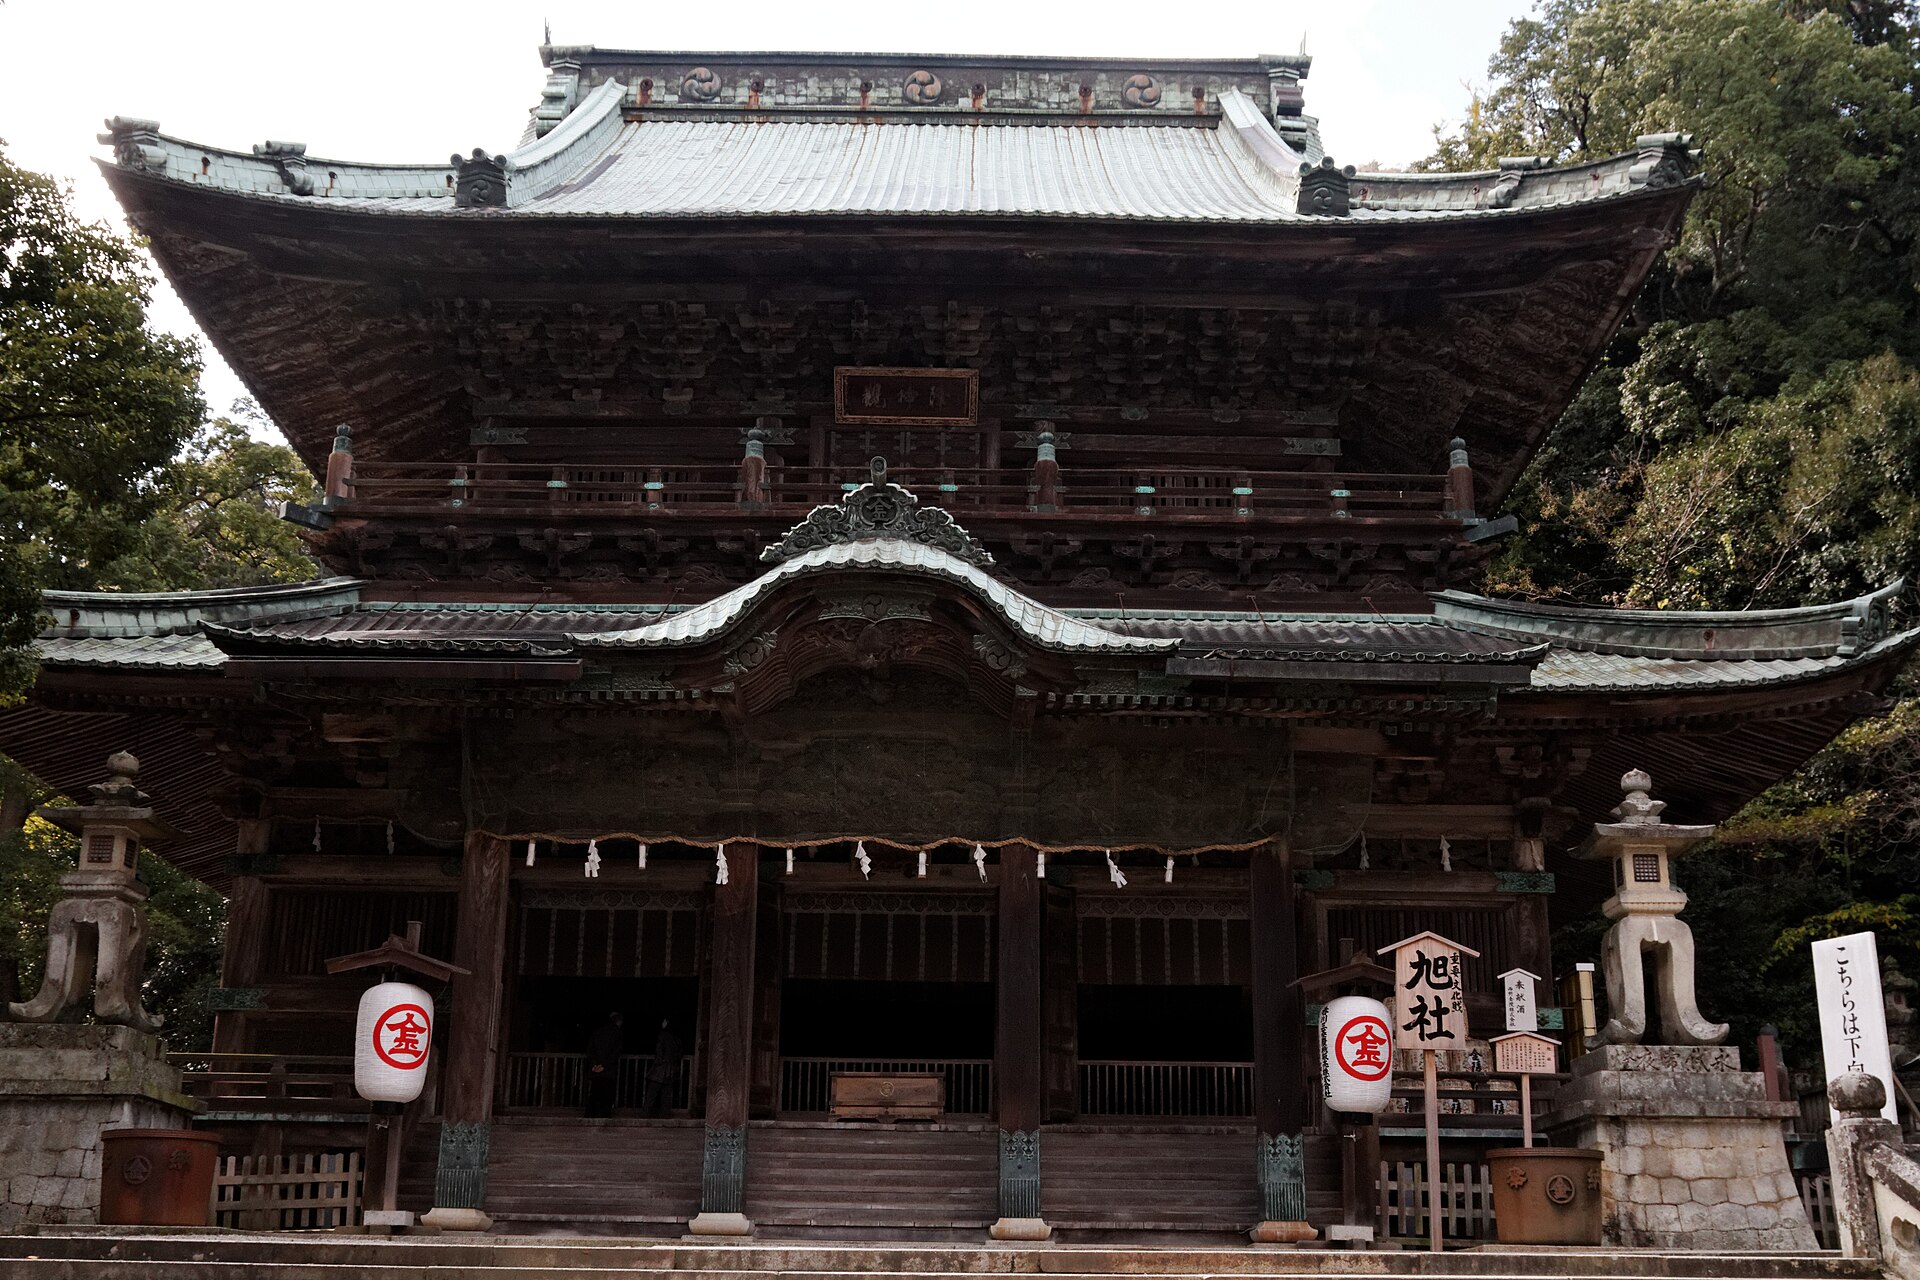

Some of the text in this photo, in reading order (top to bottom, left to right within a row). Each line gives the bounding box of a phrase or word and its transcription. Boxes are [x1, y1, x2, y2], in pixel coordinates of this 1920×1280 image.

[865, 496, 894, 522] 金
[1402, 949, 1456, 1042] 旭社
[1449, 952, 1464, 1014] 重要文化財
[1514, 979, 1527, 1014] 奉献酒
[384, 1010, 429, 1060] 金
[1344, 1022, 1389, 1071] 金
